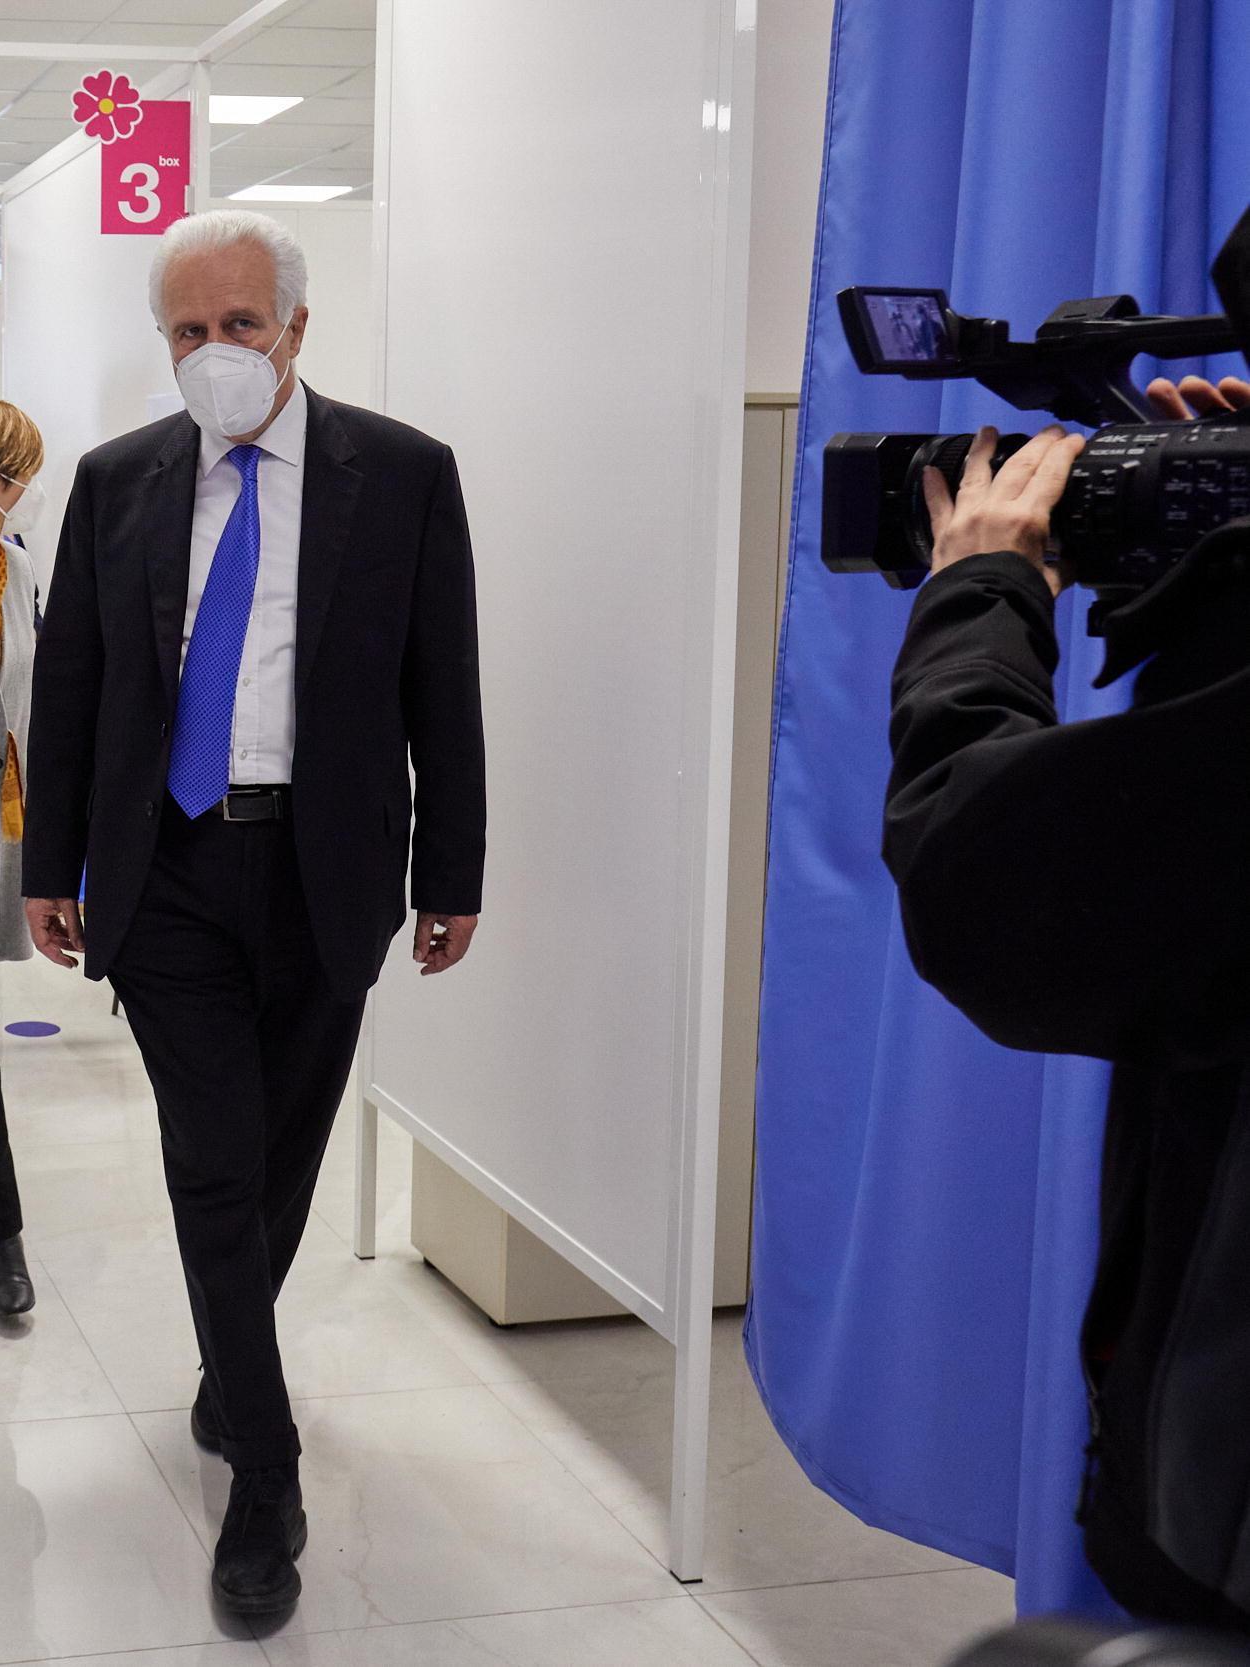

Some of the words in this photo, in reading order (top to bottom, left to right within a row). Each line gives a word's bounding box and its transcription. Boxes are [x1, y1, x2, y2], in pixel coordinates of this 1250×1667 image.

[159, 155, 180, 167] box
[117, 162, 162, 223] 3
[1095, 434, 1129, 443] 4K
